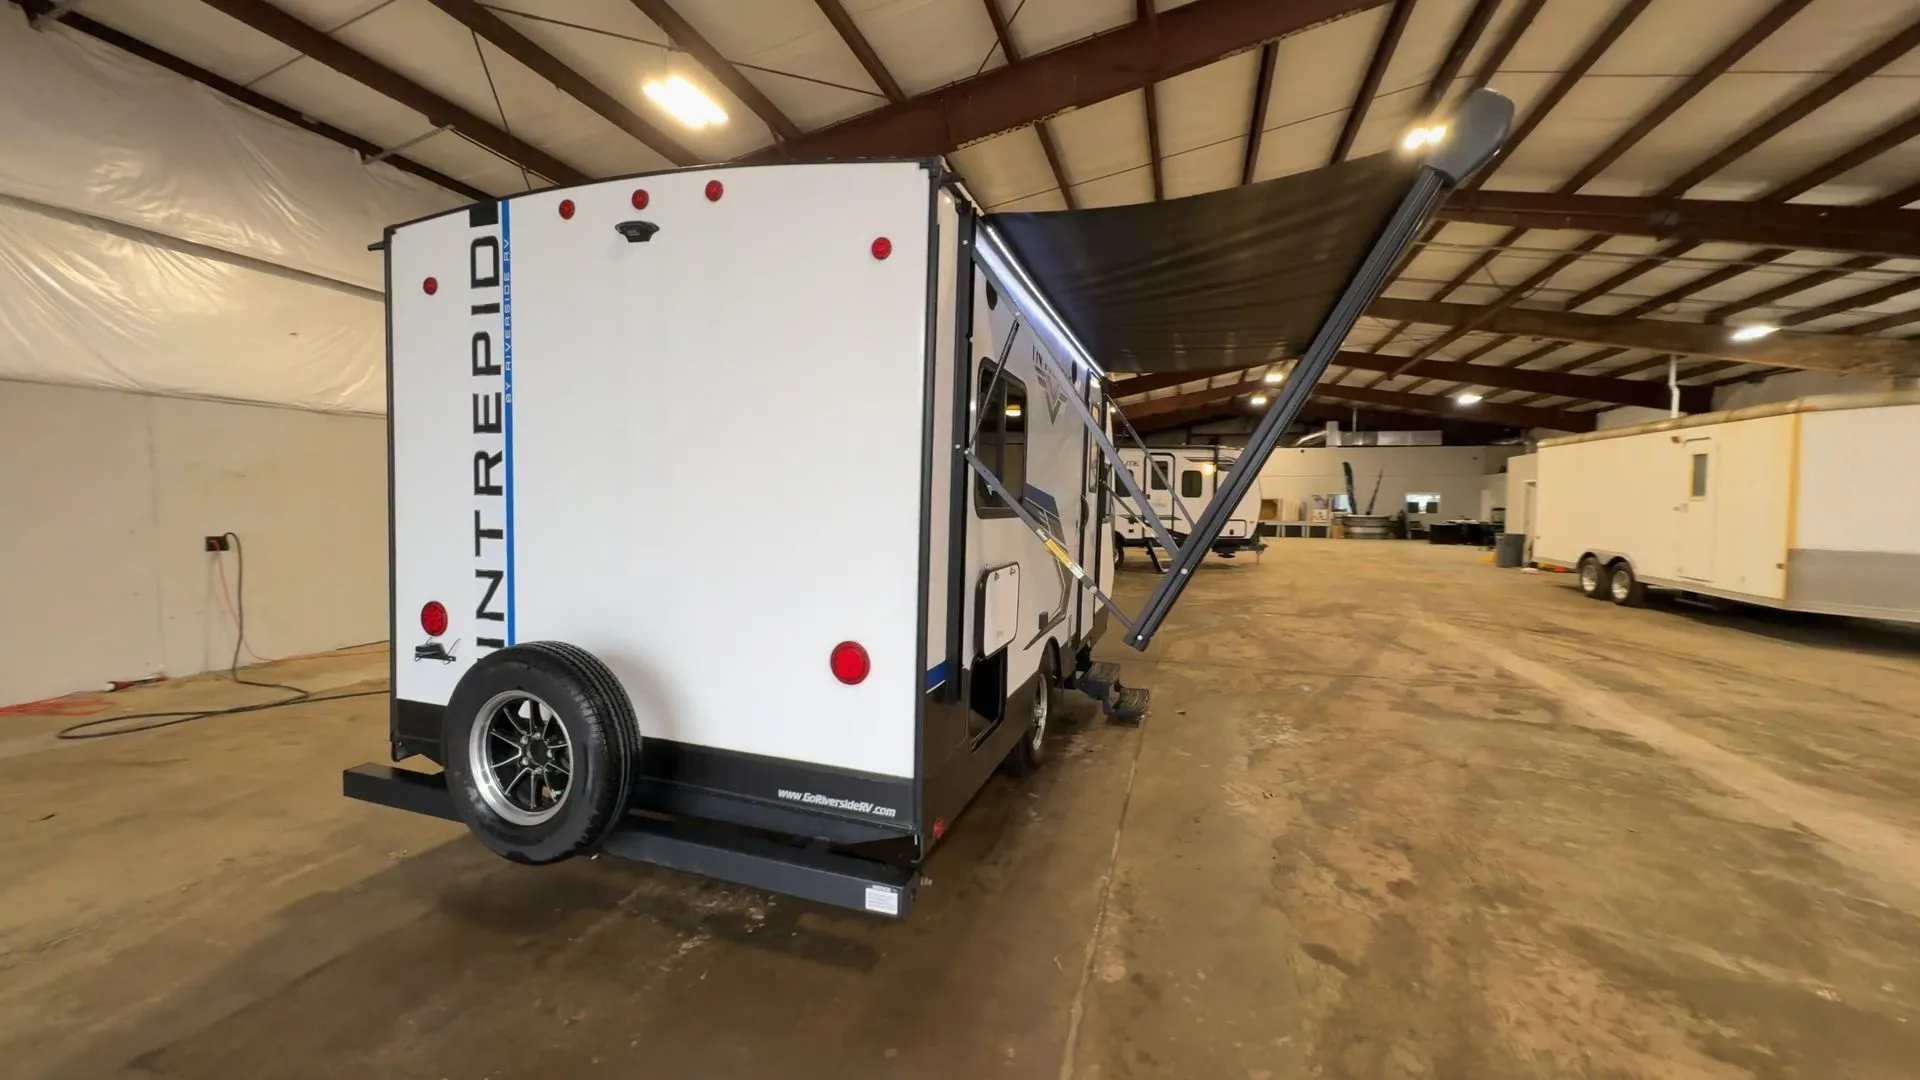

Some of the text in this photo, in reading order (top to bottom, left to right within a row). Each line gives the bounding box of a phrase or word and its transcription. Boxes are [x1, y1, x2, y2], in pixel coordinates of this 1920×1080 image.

[503, 238, 512, 403] BY RIVERSIDE RV
[470, 235, 505, 648] INTREPID
[777, 789, 897, 818] www.GoRiversideRV.com
